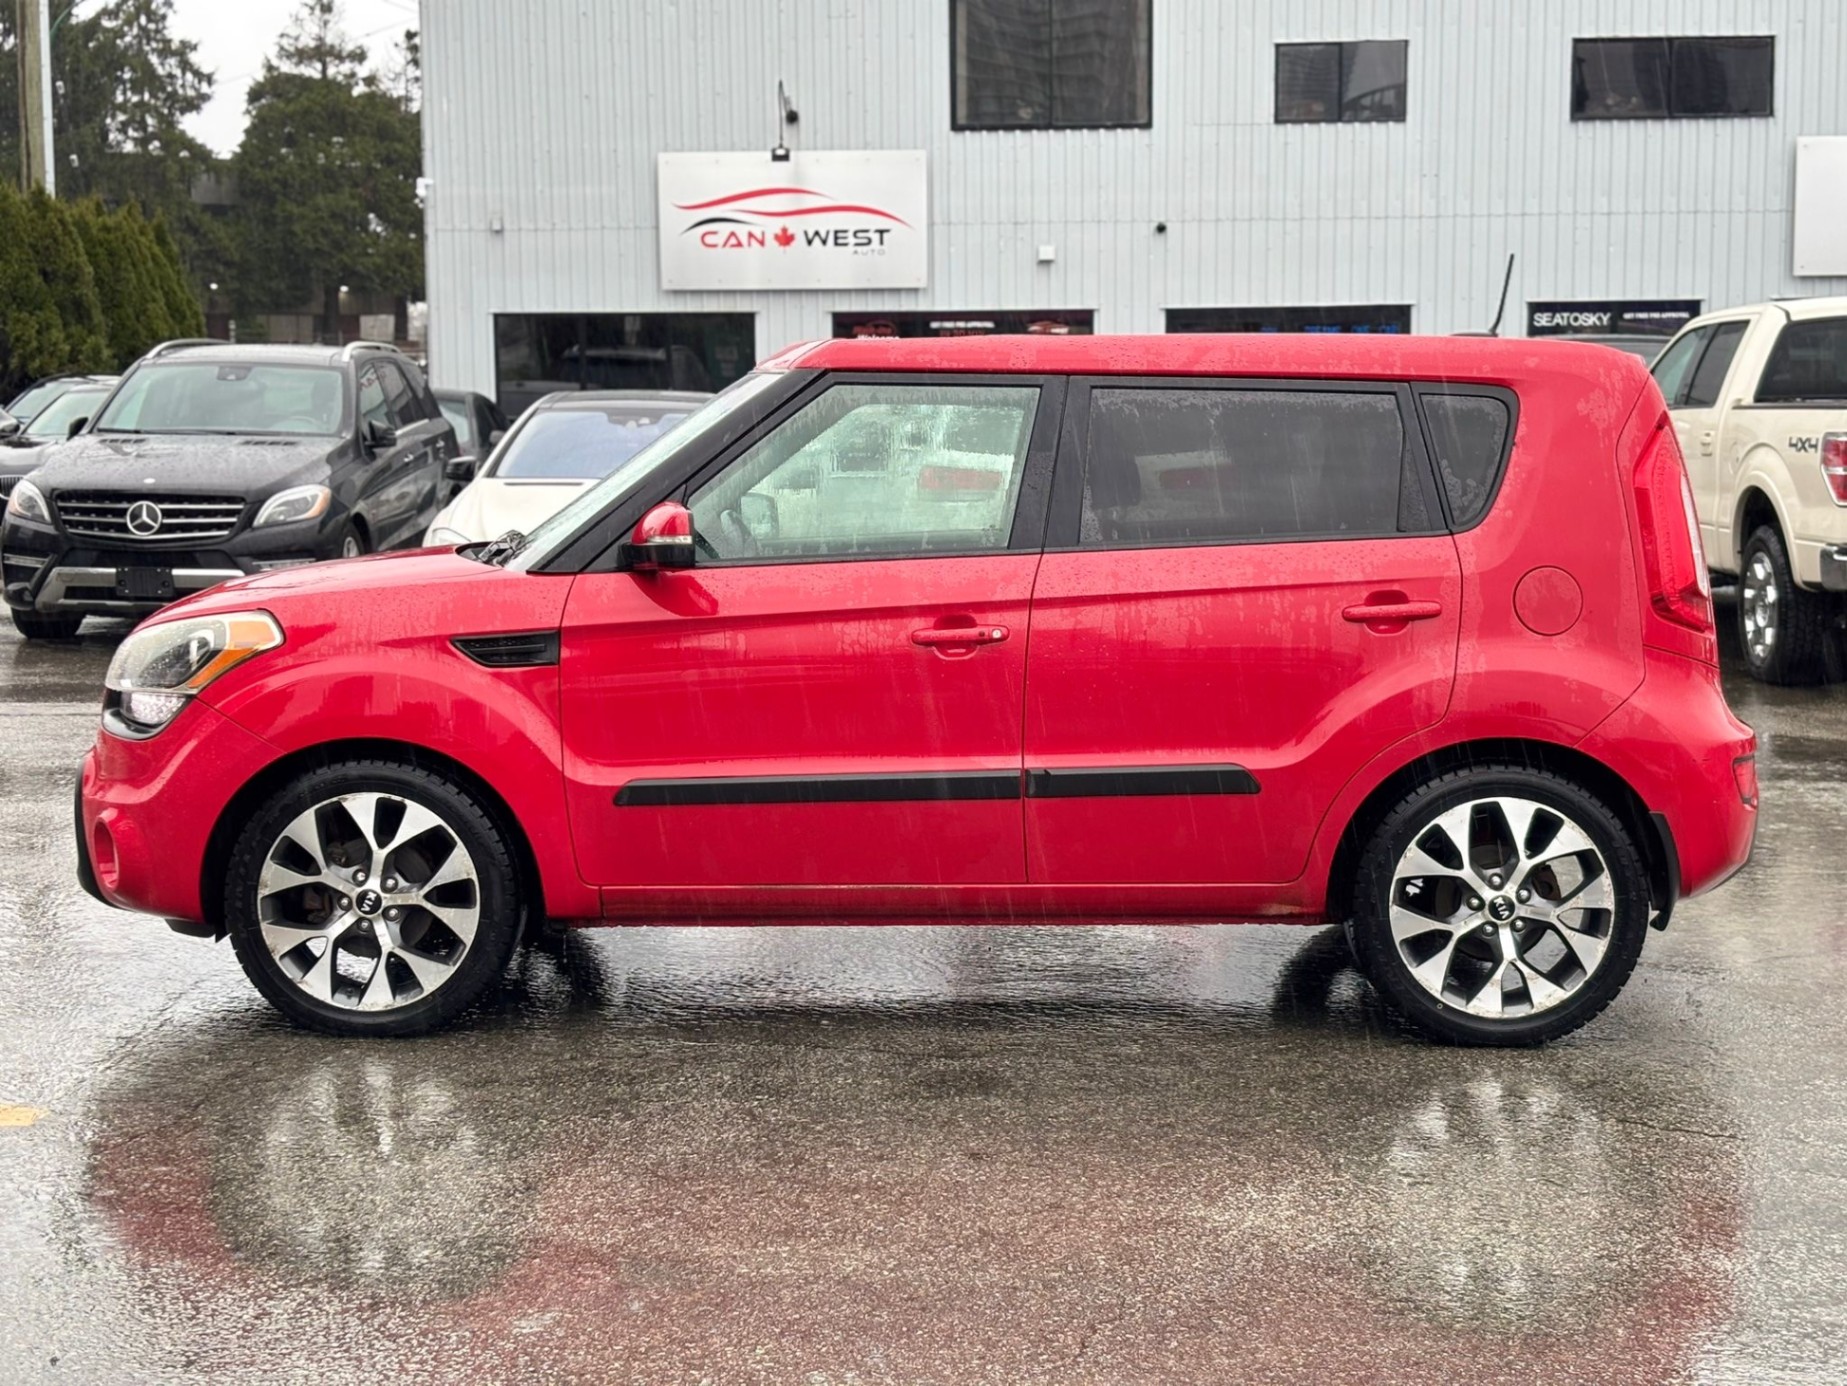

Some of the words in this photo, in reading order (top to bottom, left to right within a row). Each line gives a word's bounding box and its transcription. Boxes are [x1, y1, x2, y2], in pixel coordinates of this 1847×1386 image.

[700, 230, 766, 249] CAN
[803, 228, 892, 248] WEST
[852, 248, 886, 257] AUTO
[1533, 311, 1612, 328] SEATOSKY
[1788, 436, 1820, 453] 4X4
[360, 891, 378, 911] KIA
[1493, 896, 1510, 919] KIA
